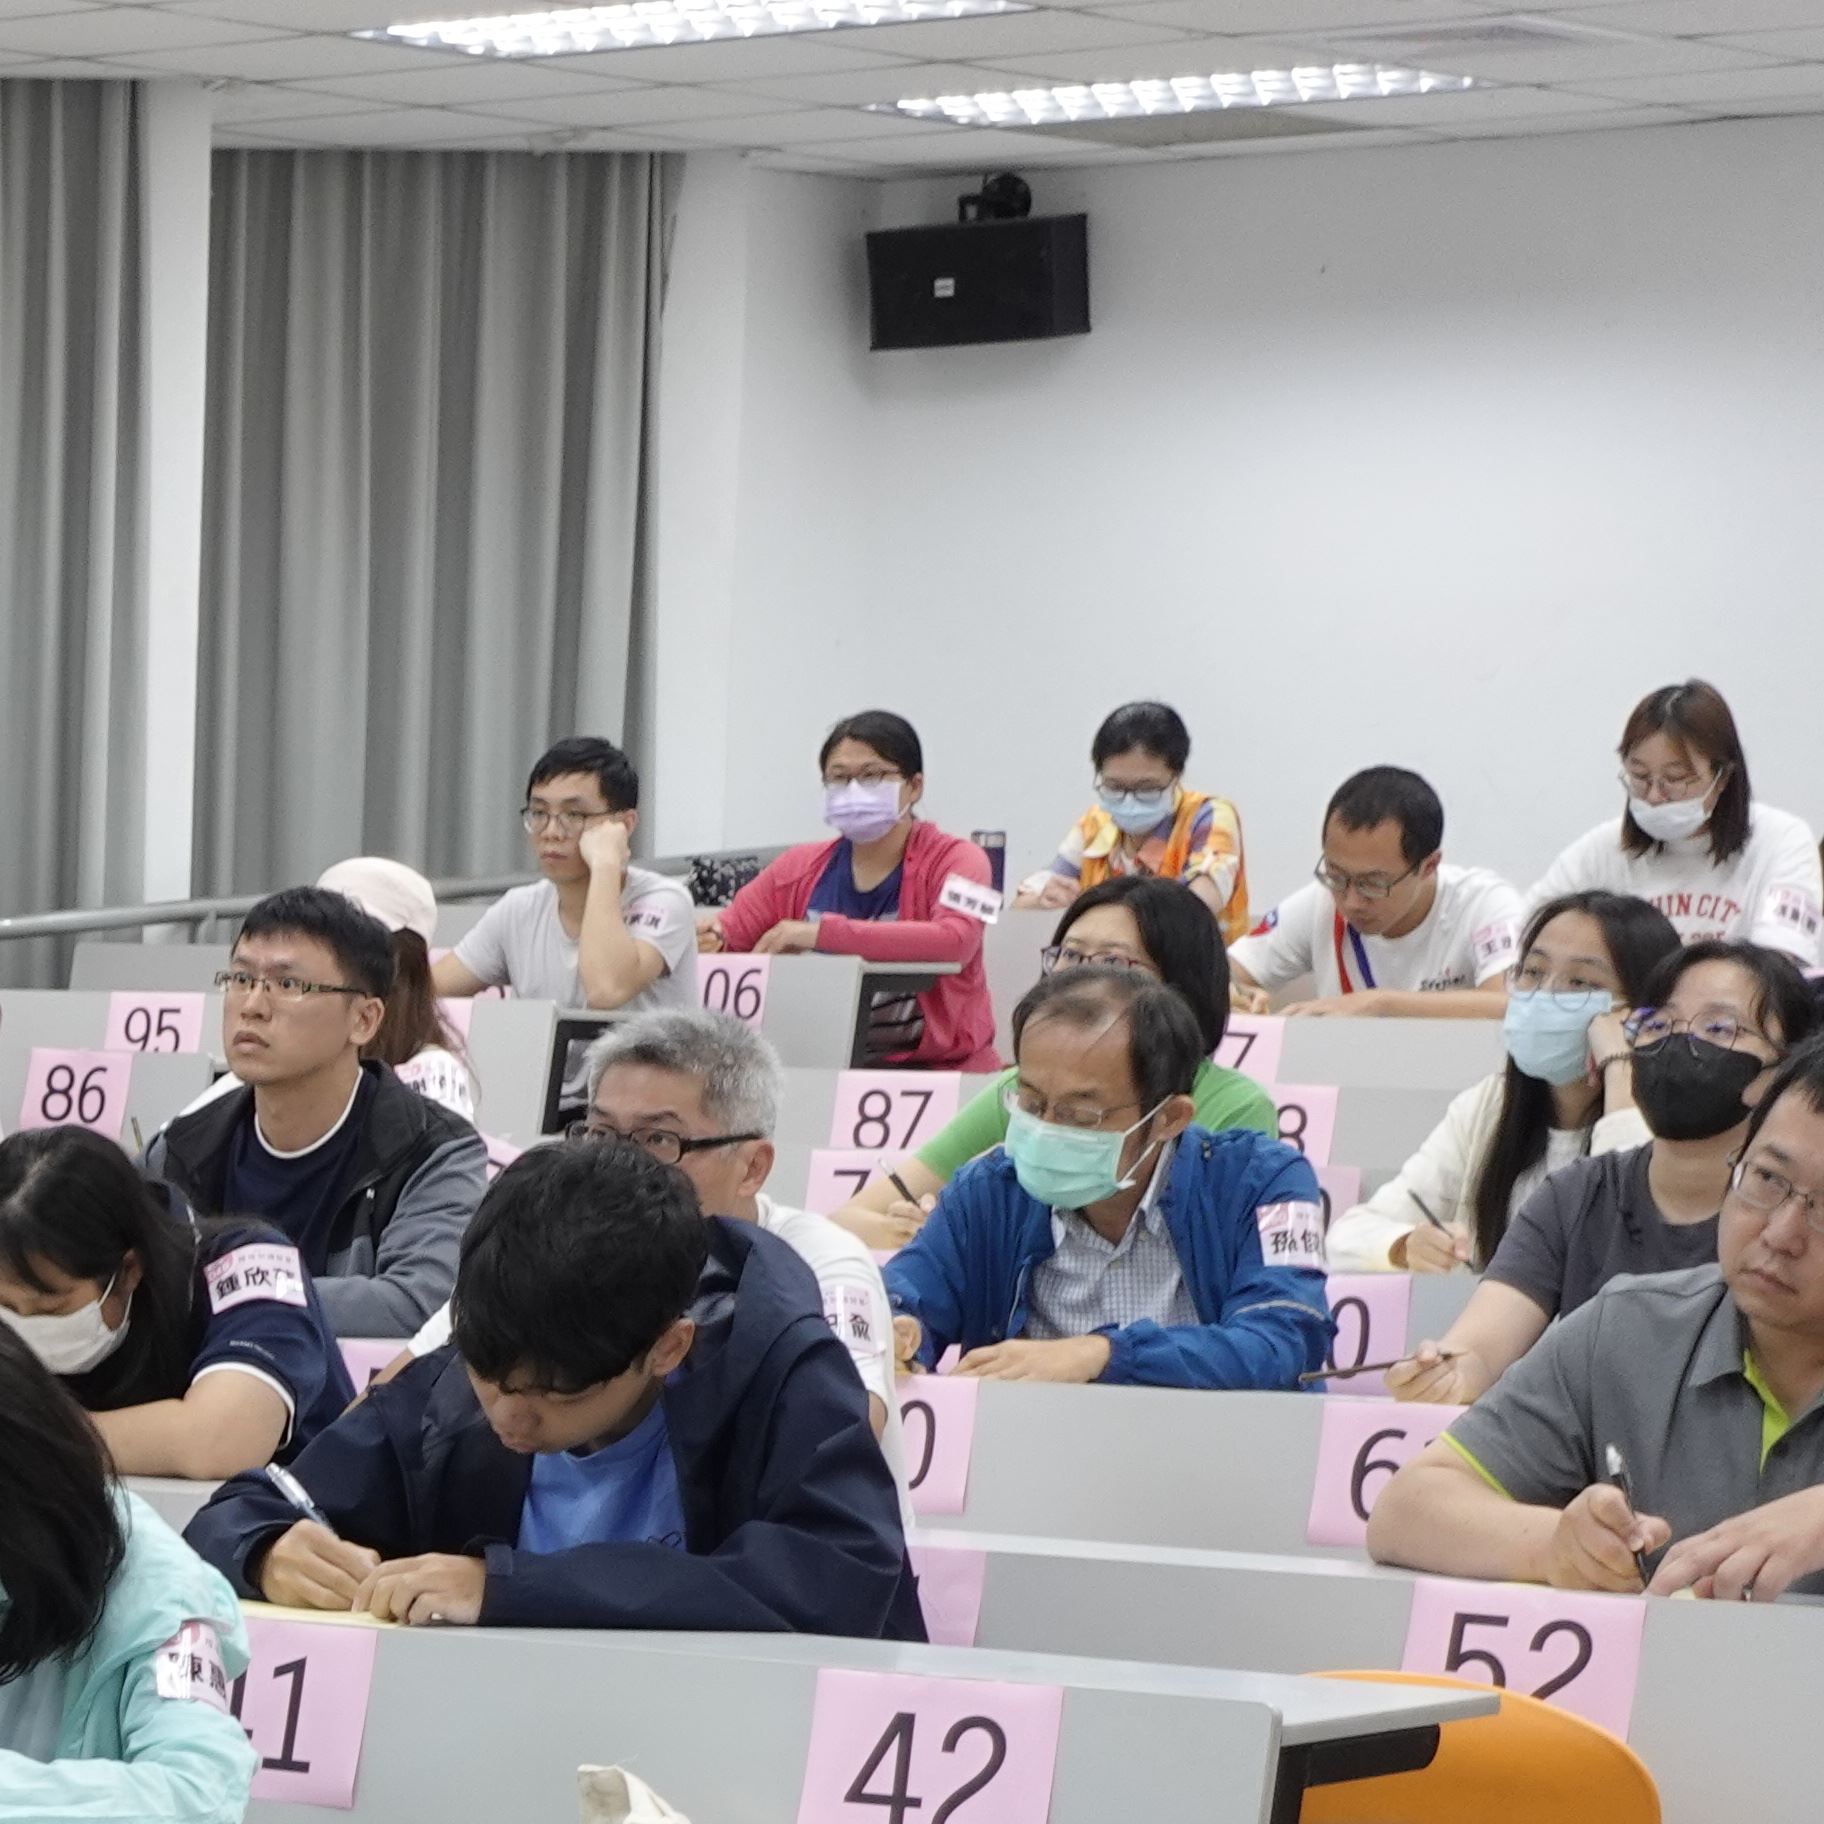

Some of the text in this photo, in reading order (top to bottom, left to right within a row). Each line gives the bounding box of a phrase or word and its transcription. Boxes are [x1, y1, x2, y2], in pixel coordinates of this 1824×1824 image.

[703, 968, 762, 1021] 06
[124, 1007, 181, 1052] 95
[1225, 1031, 1258, 1069] 7
[41, 1064, 108, 1124] 86
[852, 1089, 934, 1150] 87
[1331, 1296, 1371, 1379] 0
[1445, 1612, 1593, 1701] 52
